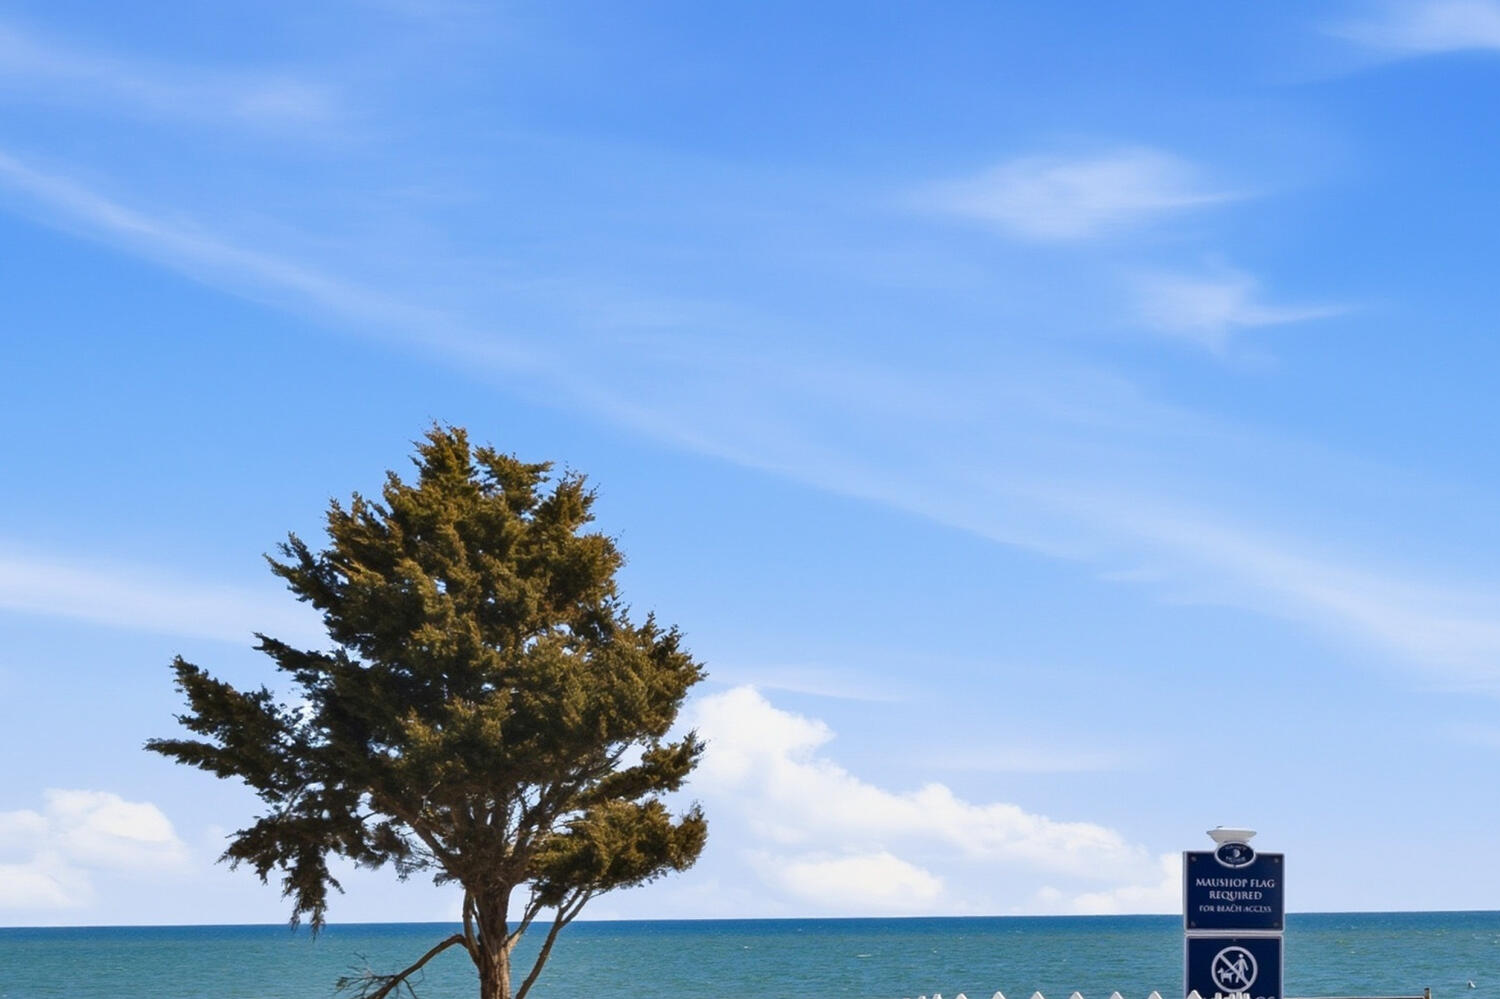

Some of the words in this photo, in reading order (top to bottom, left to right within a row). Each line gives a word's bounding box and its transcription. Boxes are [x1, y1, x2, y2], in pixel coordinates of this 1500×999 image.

[1195, 878, 1248, 888] MAUSHOP
[1250, 879, 1275, 889] FLAG
[1208, 890, 1263, 902] REQUIRED
